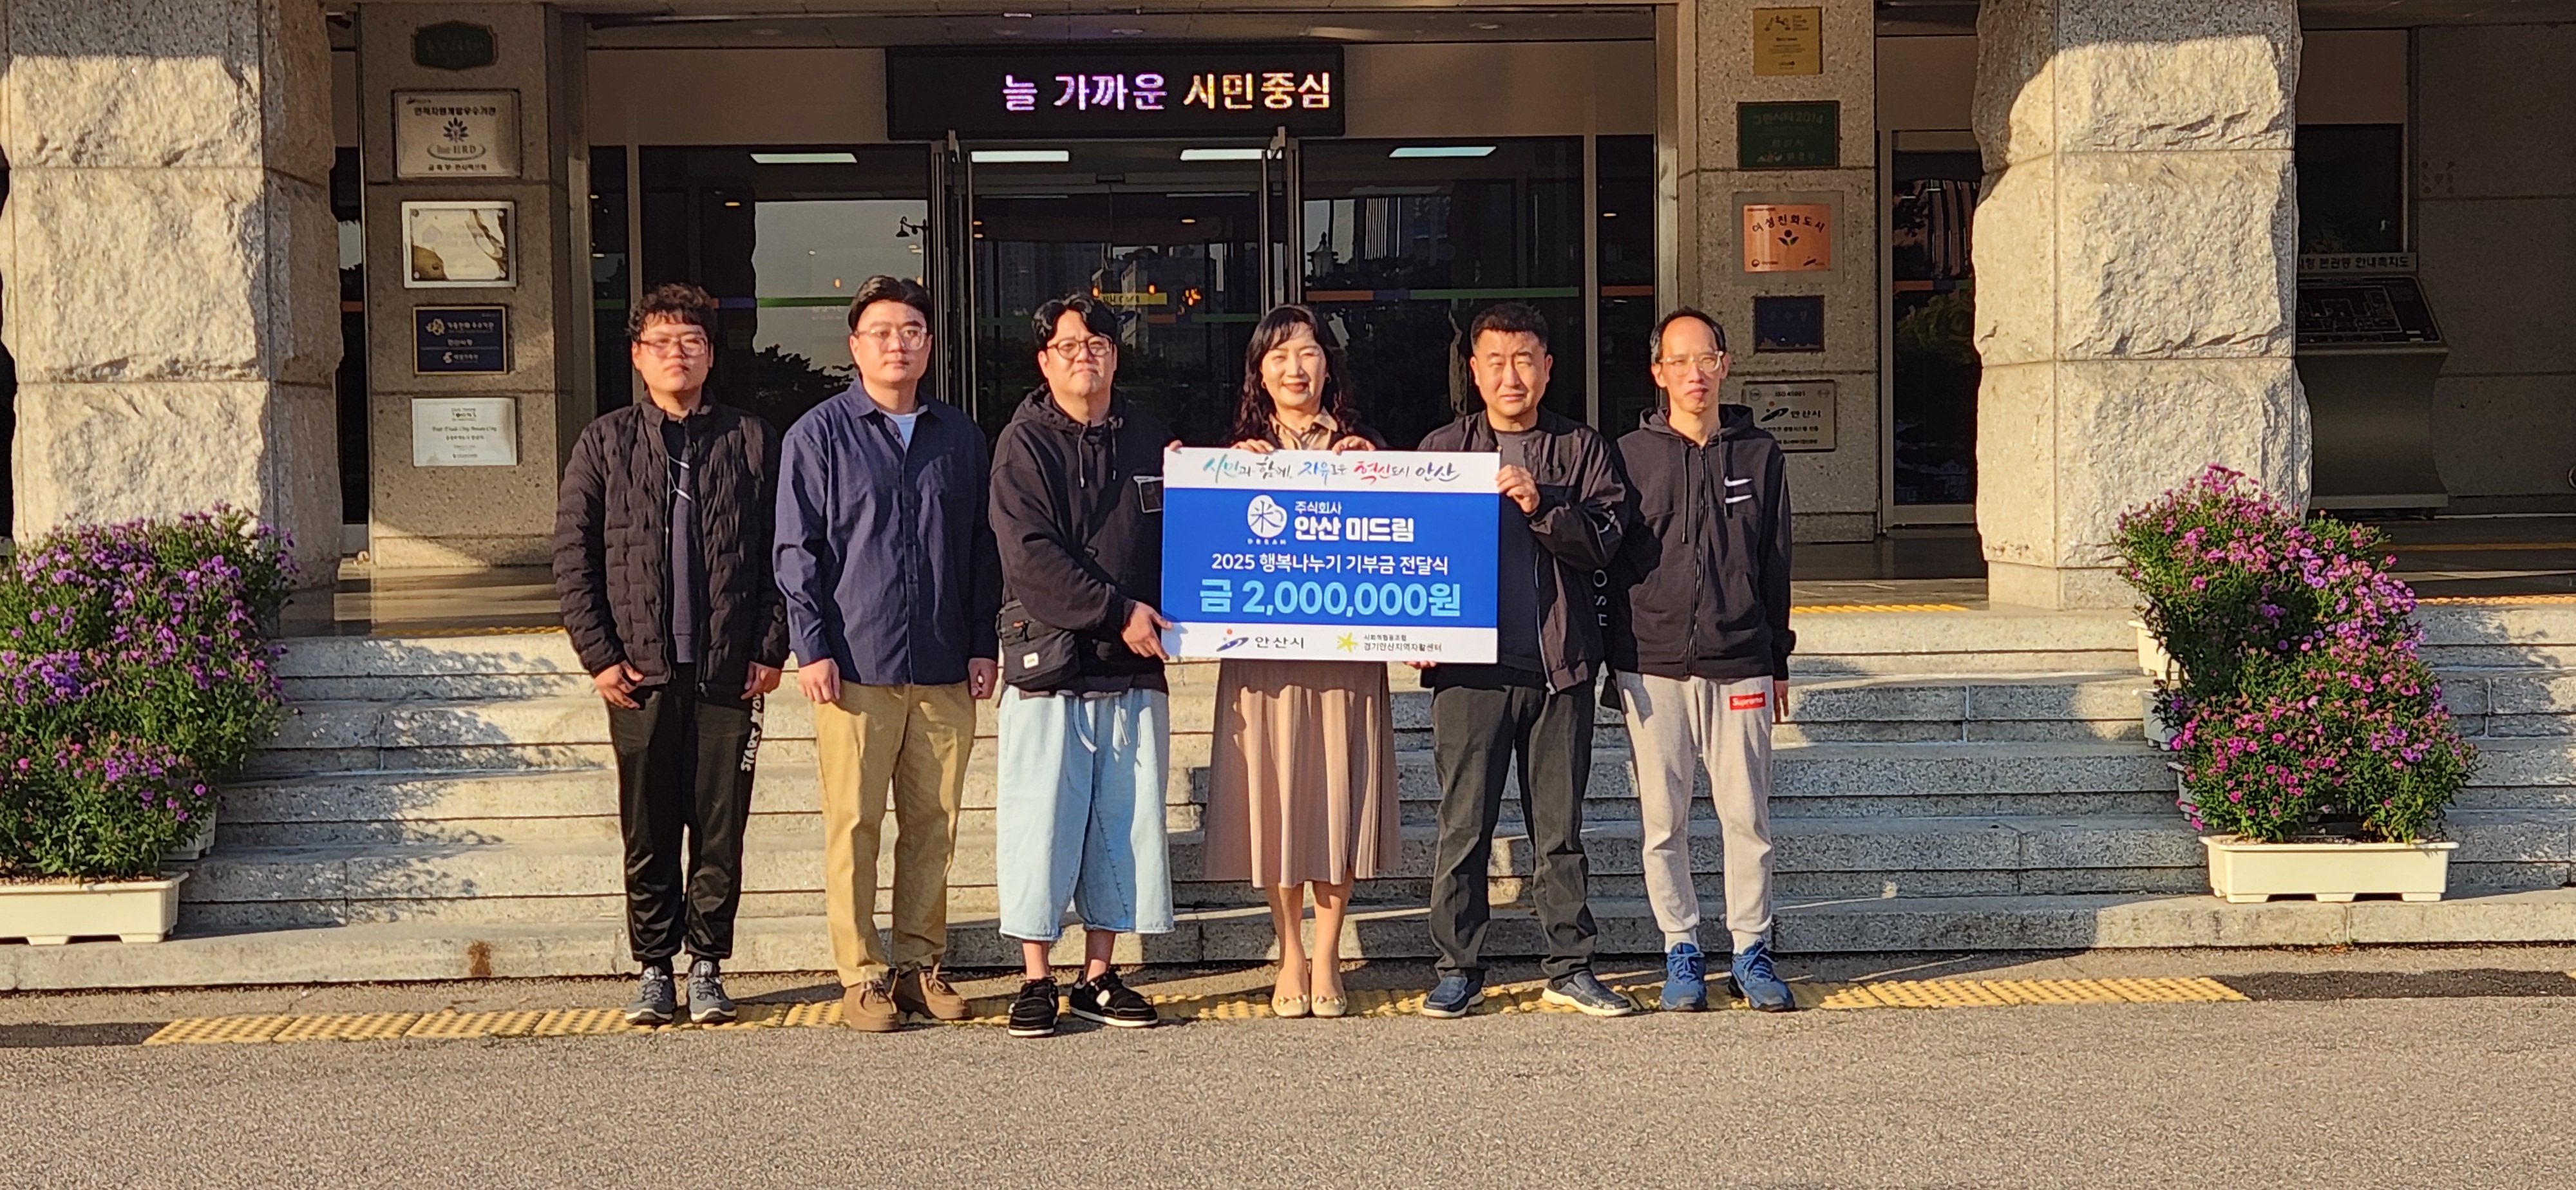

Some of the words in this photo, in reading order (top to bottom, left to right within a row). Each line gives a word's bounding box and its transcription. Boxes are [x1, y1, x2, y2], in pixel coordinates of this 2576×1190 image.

[1003, 74, 1038, 111] 늘
[1054, 73, 1168, 111] 가까운
[1183, 71, 1331, 110] 시민중심
[1752, 214, 1825, 232] 여성친화도시
[1202, 454, 1253, 484] 시민과
[1354, 460, 1409, 485] 혁신도시
[1416, 461, 1461, 483] 안산
[1294, 500, 1342, 515] 주식회사
[1294, 516, 1341, 541] 안산
[1345, 516, 1414, 542] 미드림
[1211, 553, 1255, 571] 2025
[1259, 552, 1341, 574] 행복나누기
[1346, 554, 1396, 575] 기부금
[1399, 556, 1448, 576] 전달식
[1200, 578, 1233, 613] 금
[1242, 580, 1461, 618] 2,000,000원
[1255, 636, 1304, 649] 안산시
[740, 727, 761, 771] START
